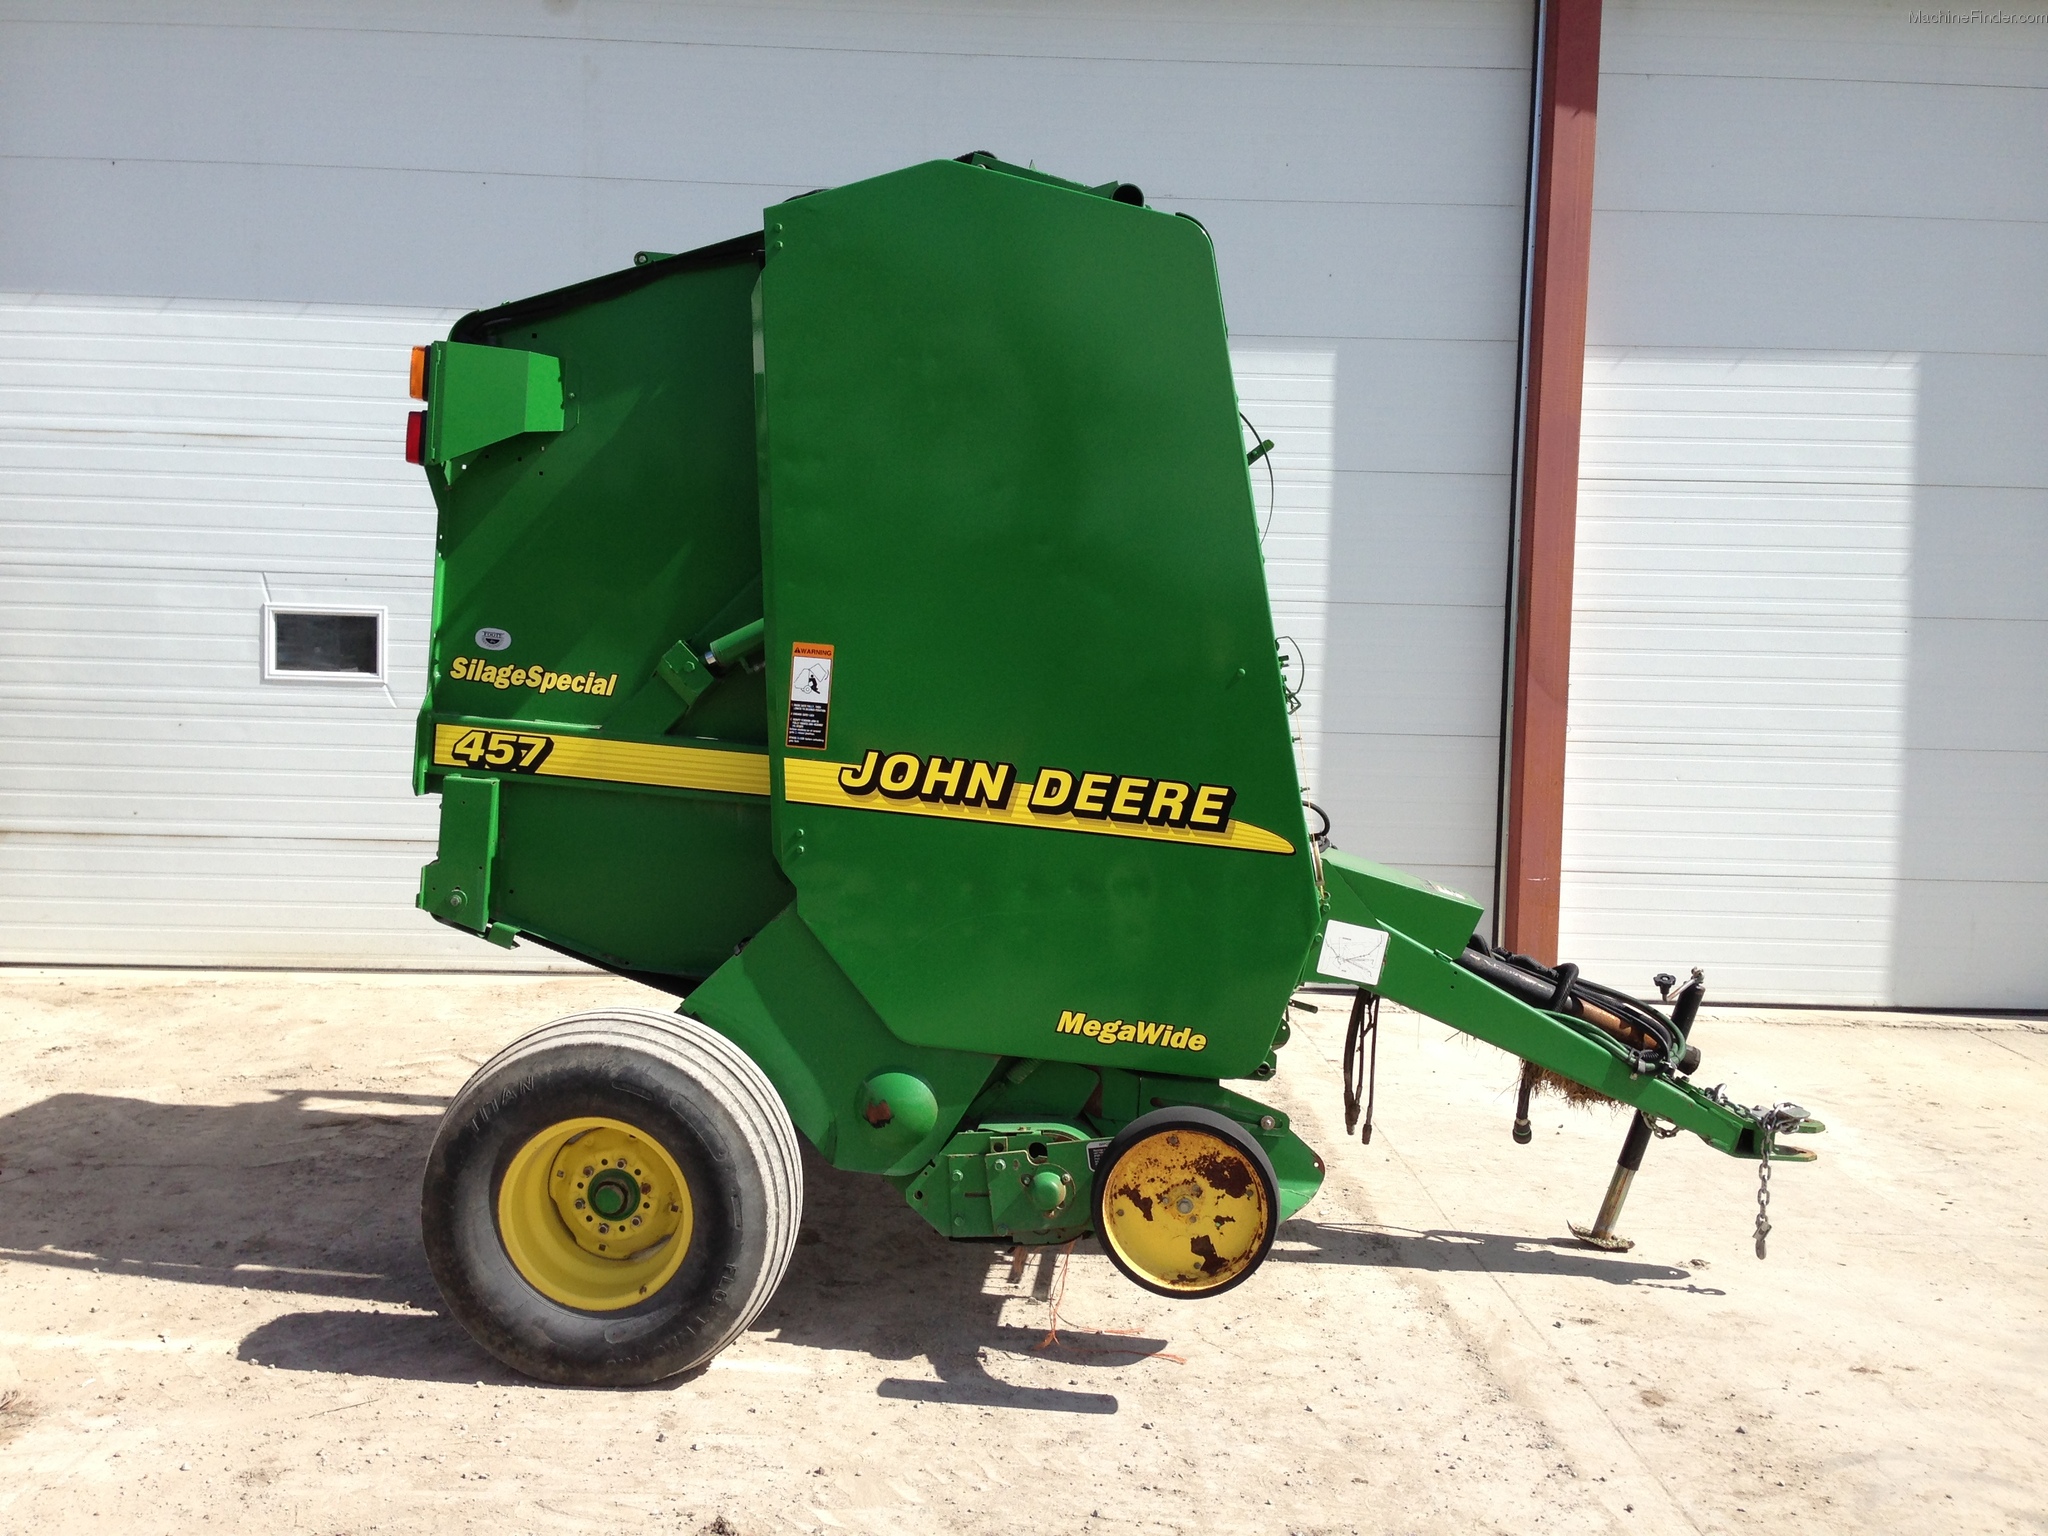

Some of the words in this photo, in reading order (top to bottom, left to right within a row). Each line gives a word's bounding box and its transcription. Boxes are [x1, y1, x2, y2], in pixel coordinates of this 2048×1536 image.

[800, 648, 832, 656] WARNING
[450, 657, 618, 696] SilageSpecial
[452, 730, 553, 772] 457
[838, 749, 1017, 810] JOHN
[1030, 767, 1236, 833] DEERE
[1055, 1010, 1208, 1052] MegaWide
[468, 1074, 535, 1133] TITAN
